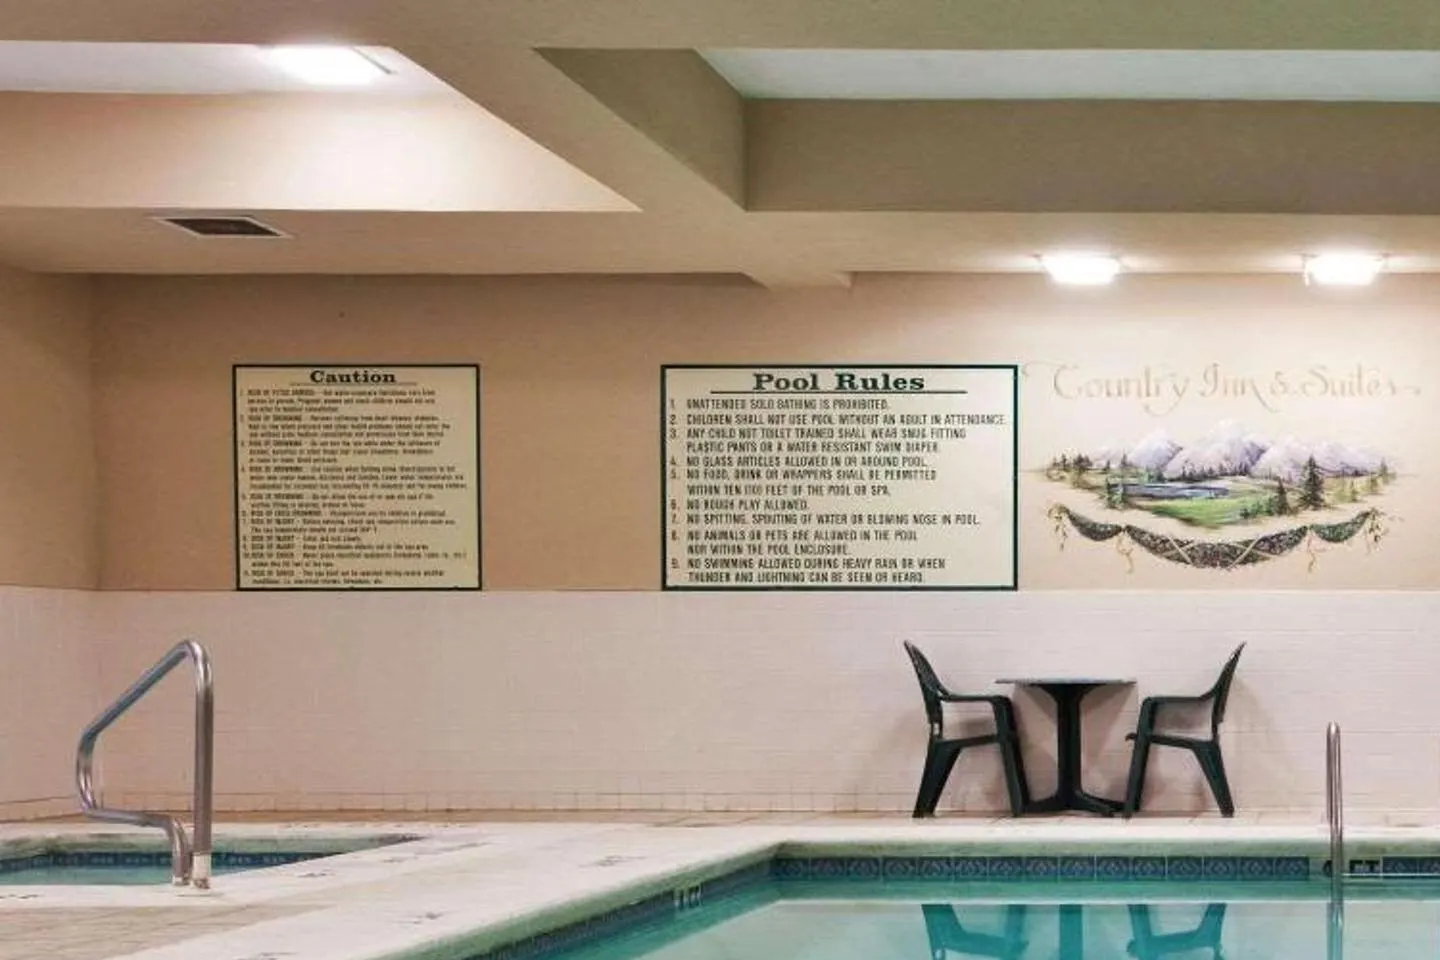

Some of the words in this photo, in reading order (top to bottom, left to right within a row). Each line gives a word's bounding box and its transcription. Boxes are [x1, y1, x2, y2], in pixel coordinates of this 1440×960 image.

[310, 370, 396, 383] Caution
[753, 372, 819, 391] Pool
[835, 372, 925, 391] Rules
[1052, 363, 1190, 416] Country
[1199, 362, 1282, 413] Inn
[1269, 370, 1297, 396] &
[1301, 362, 1397, 397] Suites
[686, 399, 748, 410] UNATTENDED
[750, 399, 774, 410] SOLO
[776, 399, 817, 410] BATHING
[819, 399, 831, 410] IS
[686, 414, 732, 425] CHILDREN
[734, 414, 765, 425] SHALL
[767, 414, 786, 425] NOT
[788, 414, 810, 425] USE
[811, 414, 836, 425] POOL
[838, 414, 881, 425] WITHOUT
[882, 414, 896, 425] AN
[897, 414, 929, 425] ADULT
[930, 414, 942, 425] IN
[687, 428, 706, 438] ANY
[707, 428, 736, 438] CHILD
[738, 428, 758, 438] NOT
[760, 428, 792, 438] TOILET
[794, 428, 834, 438] TRAINED
[836, 428, 866, 438] SHALL
[870, 428, 898, 438] WEAR
[899, 428, 929, 438] SNUG
[930, 428, 966, 438] FITTING
[686, 441, 725, 452] PLASTIC
[726, 441, 758, 452] PANTS
[759, 441, 773, 452] OR
[776, 441, 785, 452] A
[786, 441, 819, 452] WATER
[820, 441, 873, 452] RESISTANT
[874, 441, 901, 452] SWIM
[686, 456, 700, 467] NO
[702, 456, 734, 467] GLASS
[736, 456, 781, 467] ARTICLES
[784, 456, 829, 467] ALLOWED
[830, 456, 842, 467] IN
[844, 456, 857, 467] OR
[859, 456, 900, 467] AROUND
[687, 470, 700, 480] NO
[733, 470, 763, 480] DRINK
[765, 470, 778, 480] OR
[780, 470, 833, 480] WRAPPERS
[834, 470, 865, 480] SHALL
[868, 470, 882, 480] BE
[884, 470, 936, 480] PERMITTED
[687, 485, 721, 496] WITHIN
[722, 485, 742, 496] TEN
[765, 485, 788, 496] FEET
[790, 485, 803, 496] OF
[807, 485, 825, 496] THE
[826, 485, 852, 496] POOL
[854, 485, 867, 496] OR
[686, 499, 702, 510] NO
[704, 499, 734, 510] ROUGH
[736, 499, 762, 510] PLAY
[686, 514, 702, 524] NO
[752, 514, 798, 524] SPOUTING
[799, 514, 814, 524] OF
[816, 514, 848, 524] WATER
[849, 514, 865, 524] OR
[867, 514, 910, 524] BLOWING
[911, 514, 938, 524] NOSE
[939, 514, 952, 524] IN
[686, 530, 702, 540] NO
[704, 530, 746, 540] ANIMALS
[748, 530, 762, 540] OR
[764, 530, 788, 540] PETS
[792, 530, 812, 540] ARE
[814, 530, 858, 540] ALLOWED
[859, 530, 870, 540] IN
[872, 530, 892, 540] THE
[894, 530, 917, 540] POOL
[687, 544, 708, 555] NOR
[710, 544, 744, 555] WITHIN
[745, 544, 764, 555] THE
[767, 544, 792, 555] POOL
[687, 558, 702, 569] NO
[704, 558, 756, 569] SWIMMING
[758, 558, 802, 569] ALLOWED
[804, 558, 840, 569] DURING
[842, 558, 873, 569] HEAVY
[874, 558, 898, 569] RAIN
[899, 558, 915, 569] OR
[916, 558, 946, 569] WHEN
[688, 572, 732, 582] THUNDER
[734, 572, 754, 582] AND
[755, 572, 805, 582] LIGHTNING
[807, 572, 828, 582] CAN
[830, 572, 844, 582] BE
[846, 572, 873, 582] SEEN
[874, 572, 888, 582] OR
